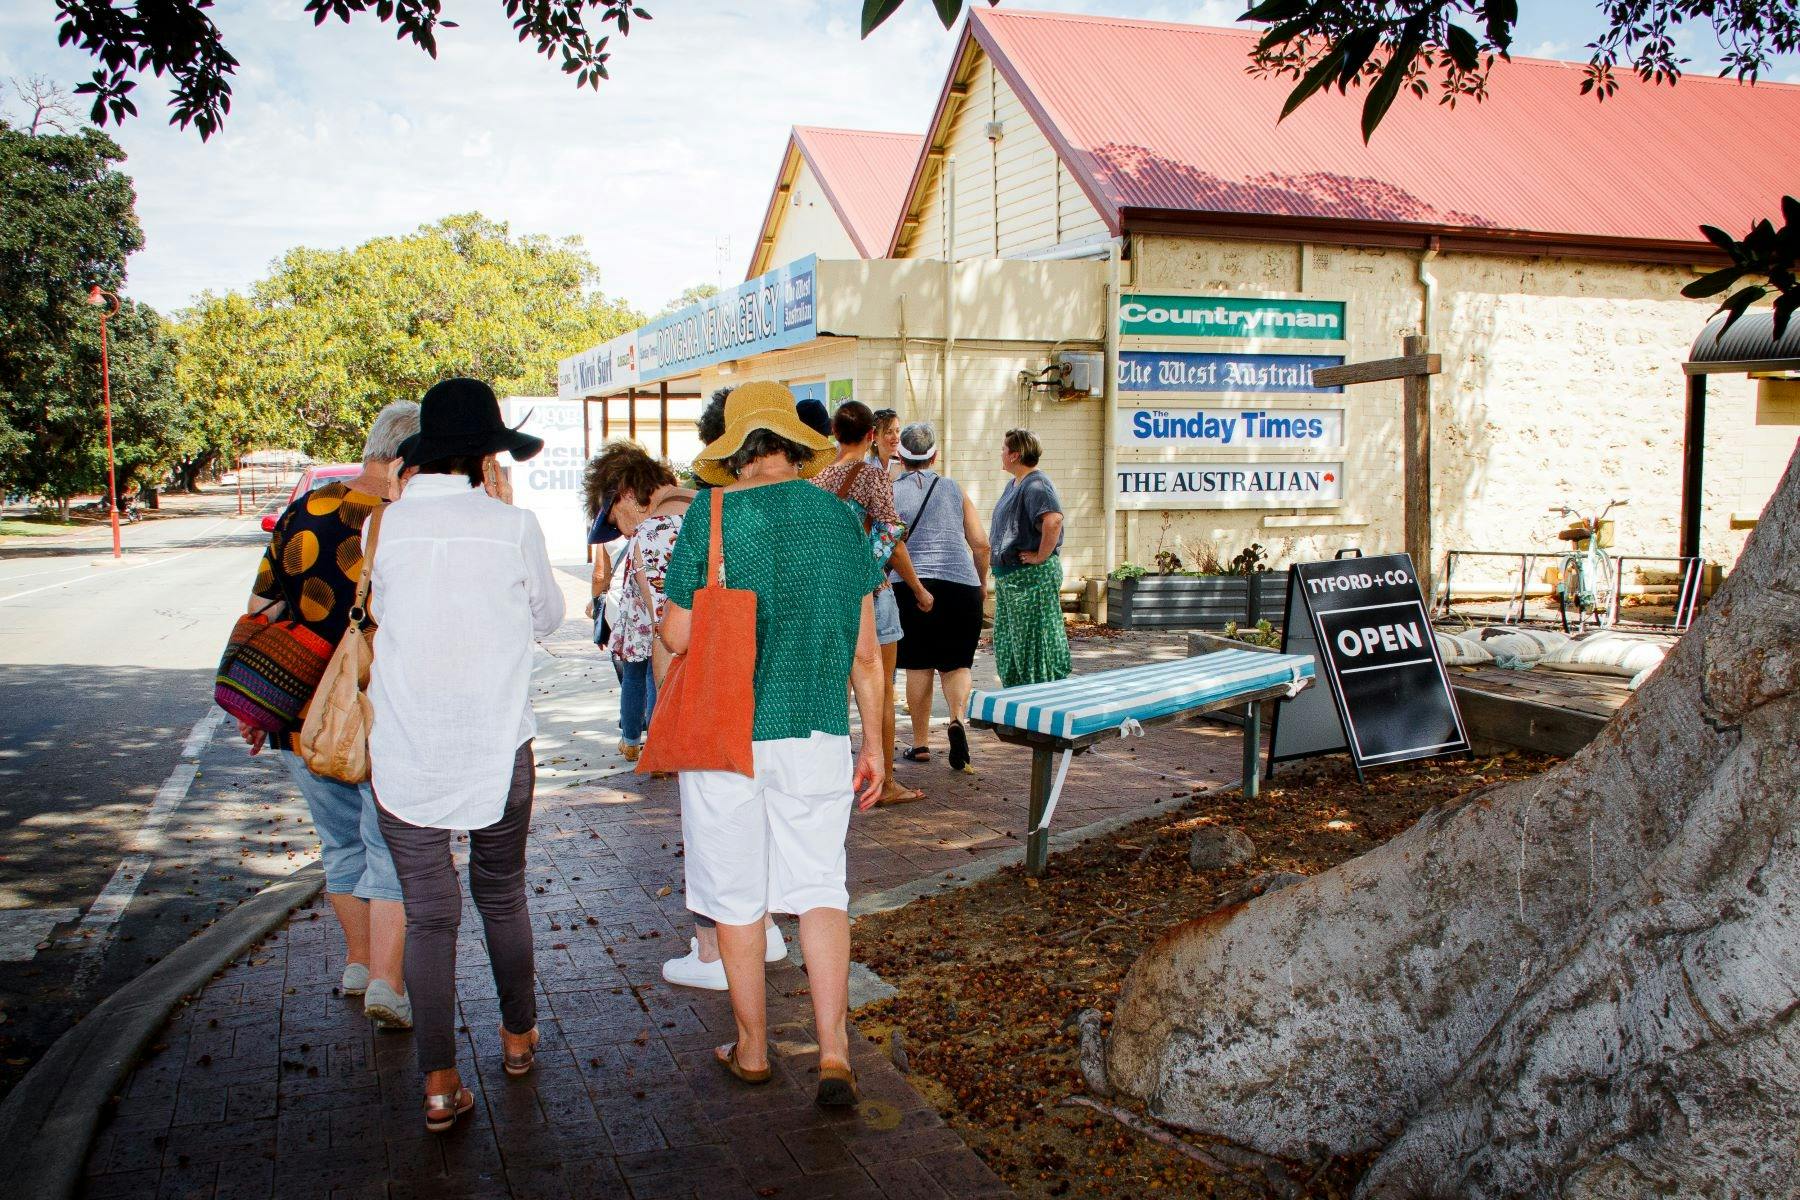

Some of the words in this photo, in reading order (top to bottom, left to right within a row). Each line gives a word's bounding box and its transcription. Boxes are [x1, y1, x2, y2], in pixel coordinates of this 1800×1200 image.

[658, 314, 701, 368] DONGARA
[701, 282, 780, 356] NEWSAGENCY
[1119, 303, 1338, 329] Countryman
[1117, 360, 1152, 384] The
[1158, 360, 1218, 385] West
[1223, 361, 1314, 386] Australi
[1132, 411, 1237, 444] Sunday
[1241, 411, 1324, 439] Times
[529, 447, 585, 467] ISH
[1117, 472, 1167, 493] THE
[1172, 471, 1321, 493] AUSTRALIAN
[1337, 621, 1423, 657] OPEN
